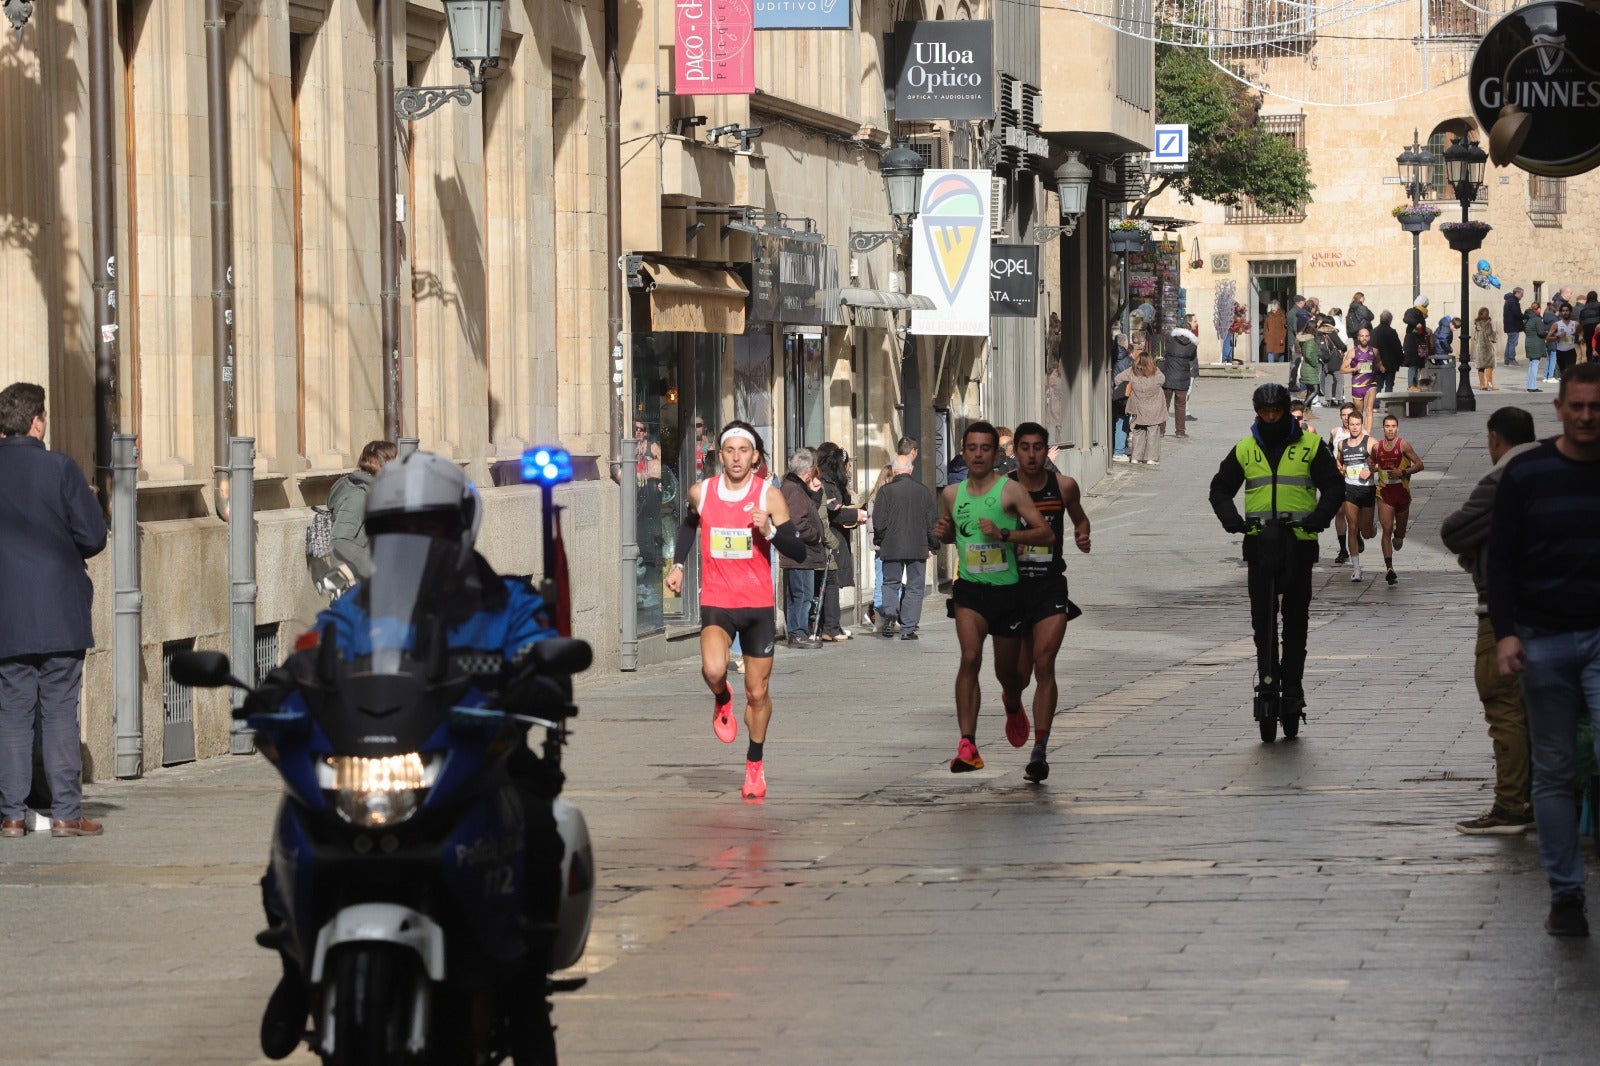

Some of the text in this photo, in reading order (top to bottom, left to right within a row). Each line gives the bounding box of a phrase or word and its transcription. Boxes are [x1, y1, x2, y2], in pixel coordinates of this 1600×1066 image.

[685, 35, 710, 81] PACO
[913, 42, 975, 64] Ulloa
[907, 65, 982, 93] Optico
[724, 536, 732, 549] 3
[980, 550, 987, 563] 5
